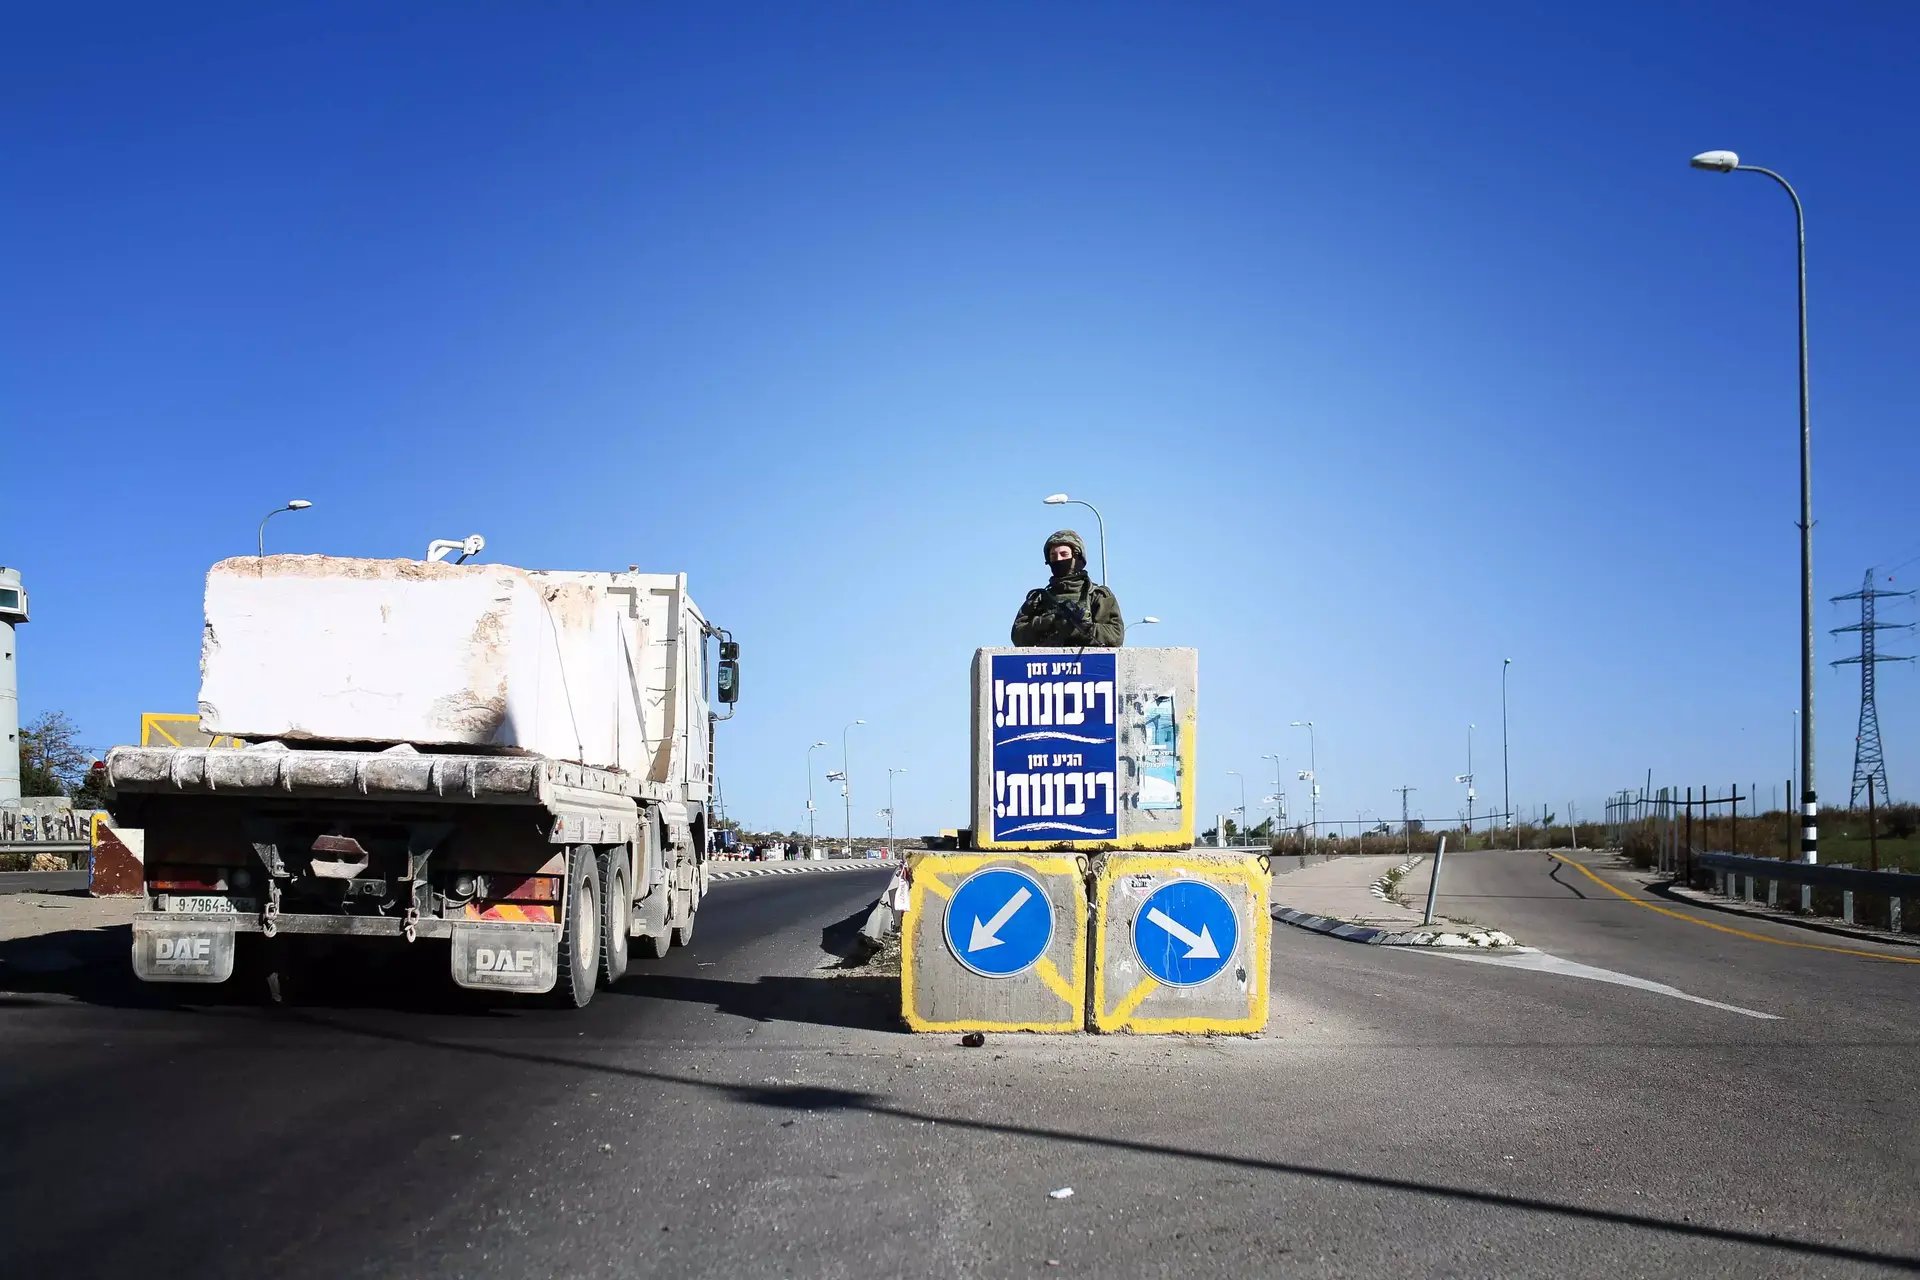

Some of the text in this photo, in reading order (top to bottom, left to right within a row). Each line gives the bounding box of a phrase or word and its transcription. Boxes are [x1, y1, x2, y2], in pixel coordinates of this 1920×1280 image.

[1026, 662, 1081, 679] הגיע זמן
[994, 679, 1114, 728] ריבונות!
[1027, 753, 1082, 770] הגיע זמן
[996, 770, 1115, 819] ריבונות!
[156, 938, 211, 959] DAF
[476, 948, 534, 971] DAF
